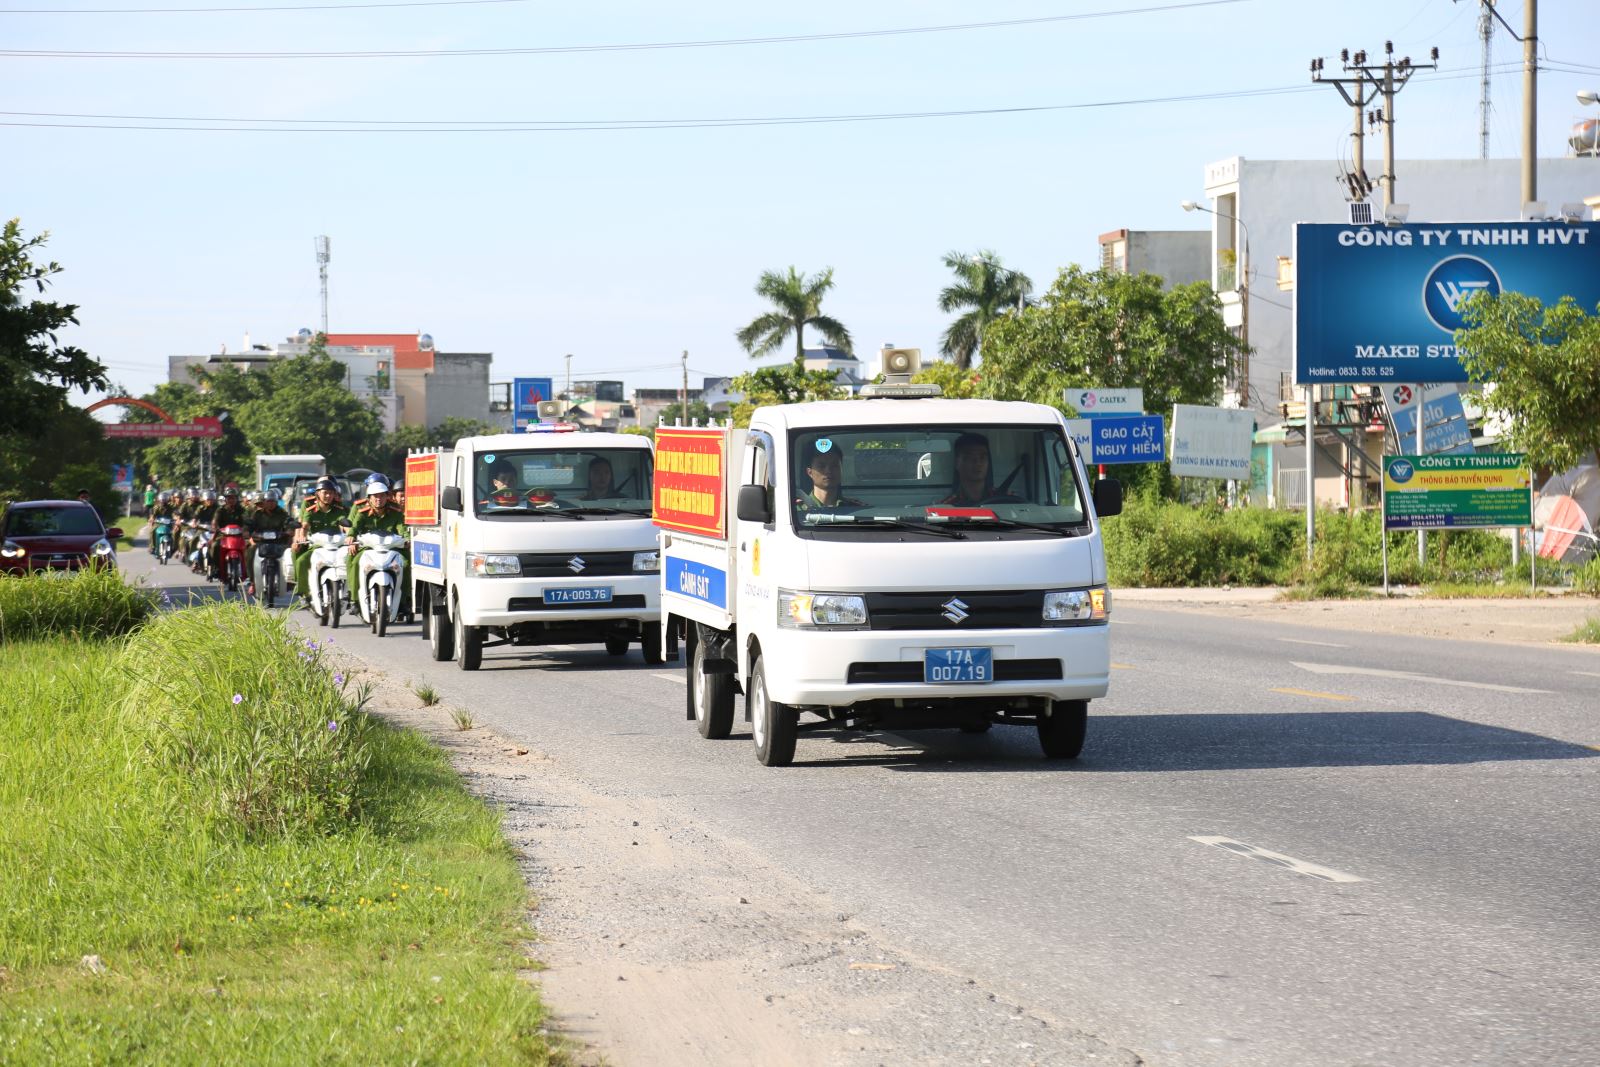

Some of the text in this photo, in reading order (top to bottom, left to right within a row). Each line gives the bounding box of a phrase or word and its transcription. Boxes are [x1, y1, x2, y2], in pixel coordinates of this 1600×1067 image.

[1338, 227, 1590, 247] CÔNG TY TNHH HVT
[1355, 345, 1469, 358] MAKE STE
[1308, 366, 1394, 377] Hotline: 0833. 535. 525
[1099, 396, 1127, 404] CALTEX
[1101, 421, 1155, 439] GIAO CẮT
[1096, 444, 1127, 456] NGUY
[1132, 437, 1161, 455] HIỂM
[1419, 456, 1525, 468] CÔNG TY TNHH HVT
[1420, 473, 1503, 485] THÔNG BÁO TUYỂN DỤNG
[680, 563, 710, 599] CẢNH SÁT
[550, 589, 606, 601] 17A-009.76
[945, 650, 973, 665] 17A
[932, 665, 985, 681] 007.19
